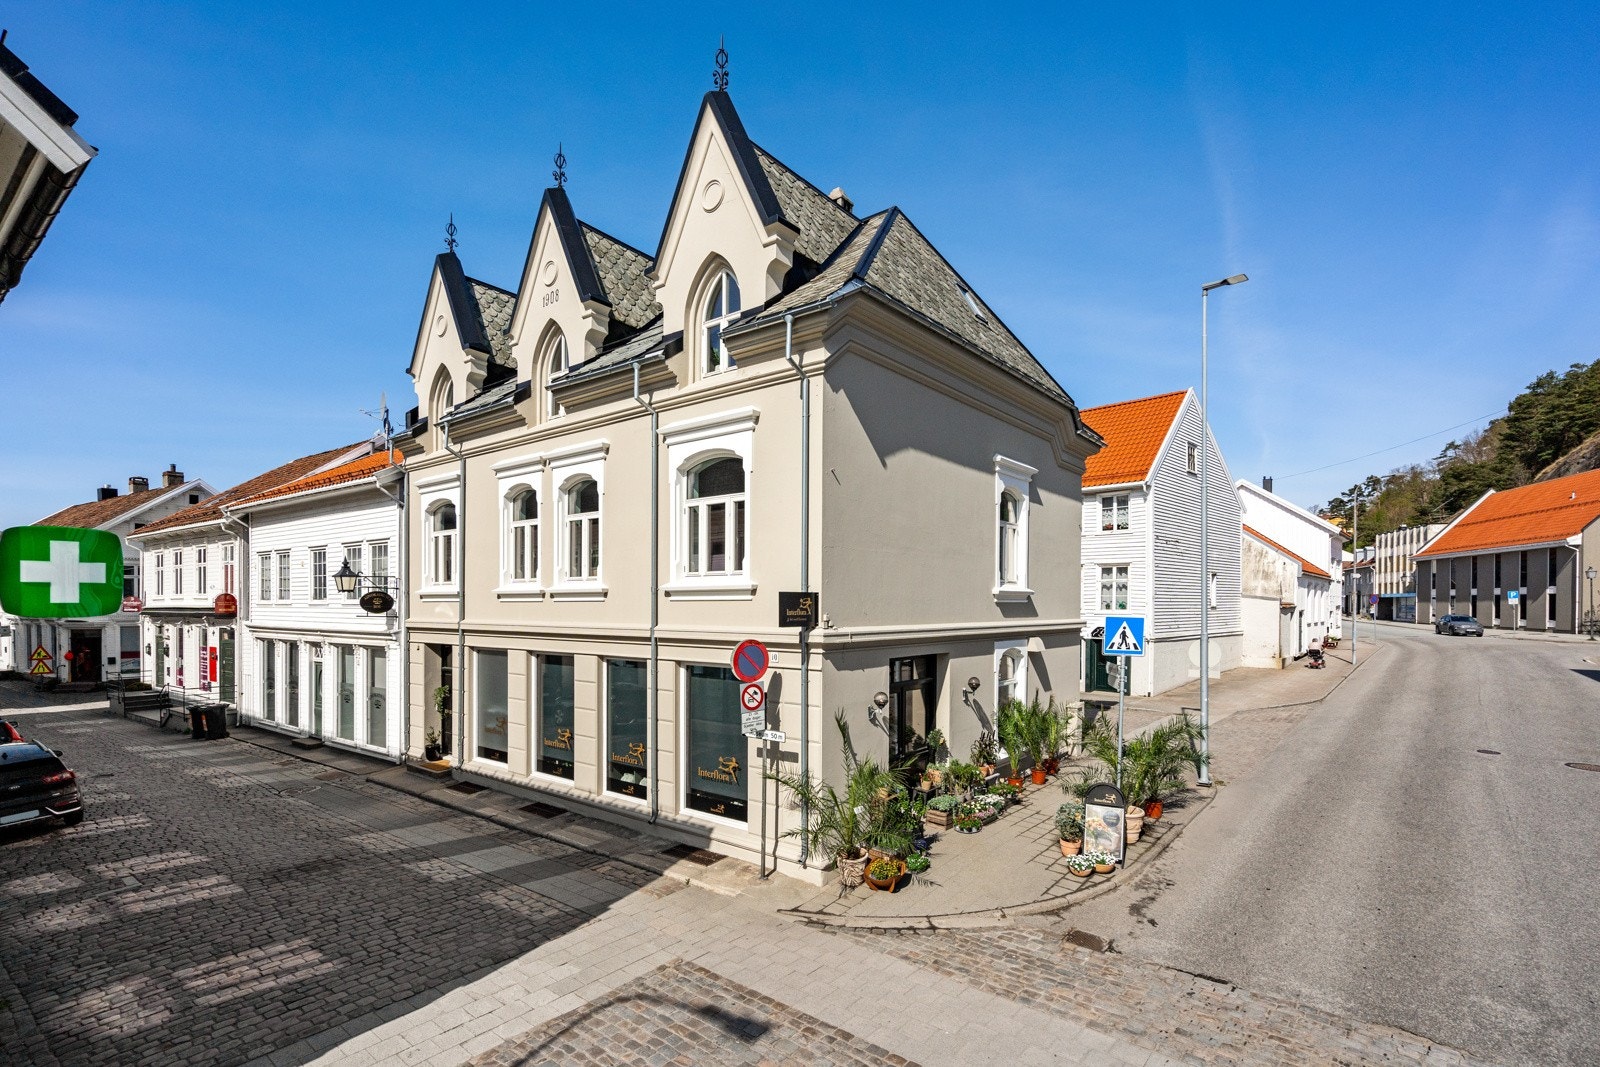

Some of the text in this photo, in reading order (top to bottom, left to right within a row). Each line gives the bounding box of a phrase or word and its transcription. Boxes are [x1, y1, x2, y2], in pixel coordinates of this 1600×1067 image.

[542, 289, 560, 307] 1908
[544, 737, 566, 749] Interflora
[612, 753, 638, 765] Interflora
[697, 766, 729, 782] Interflora
